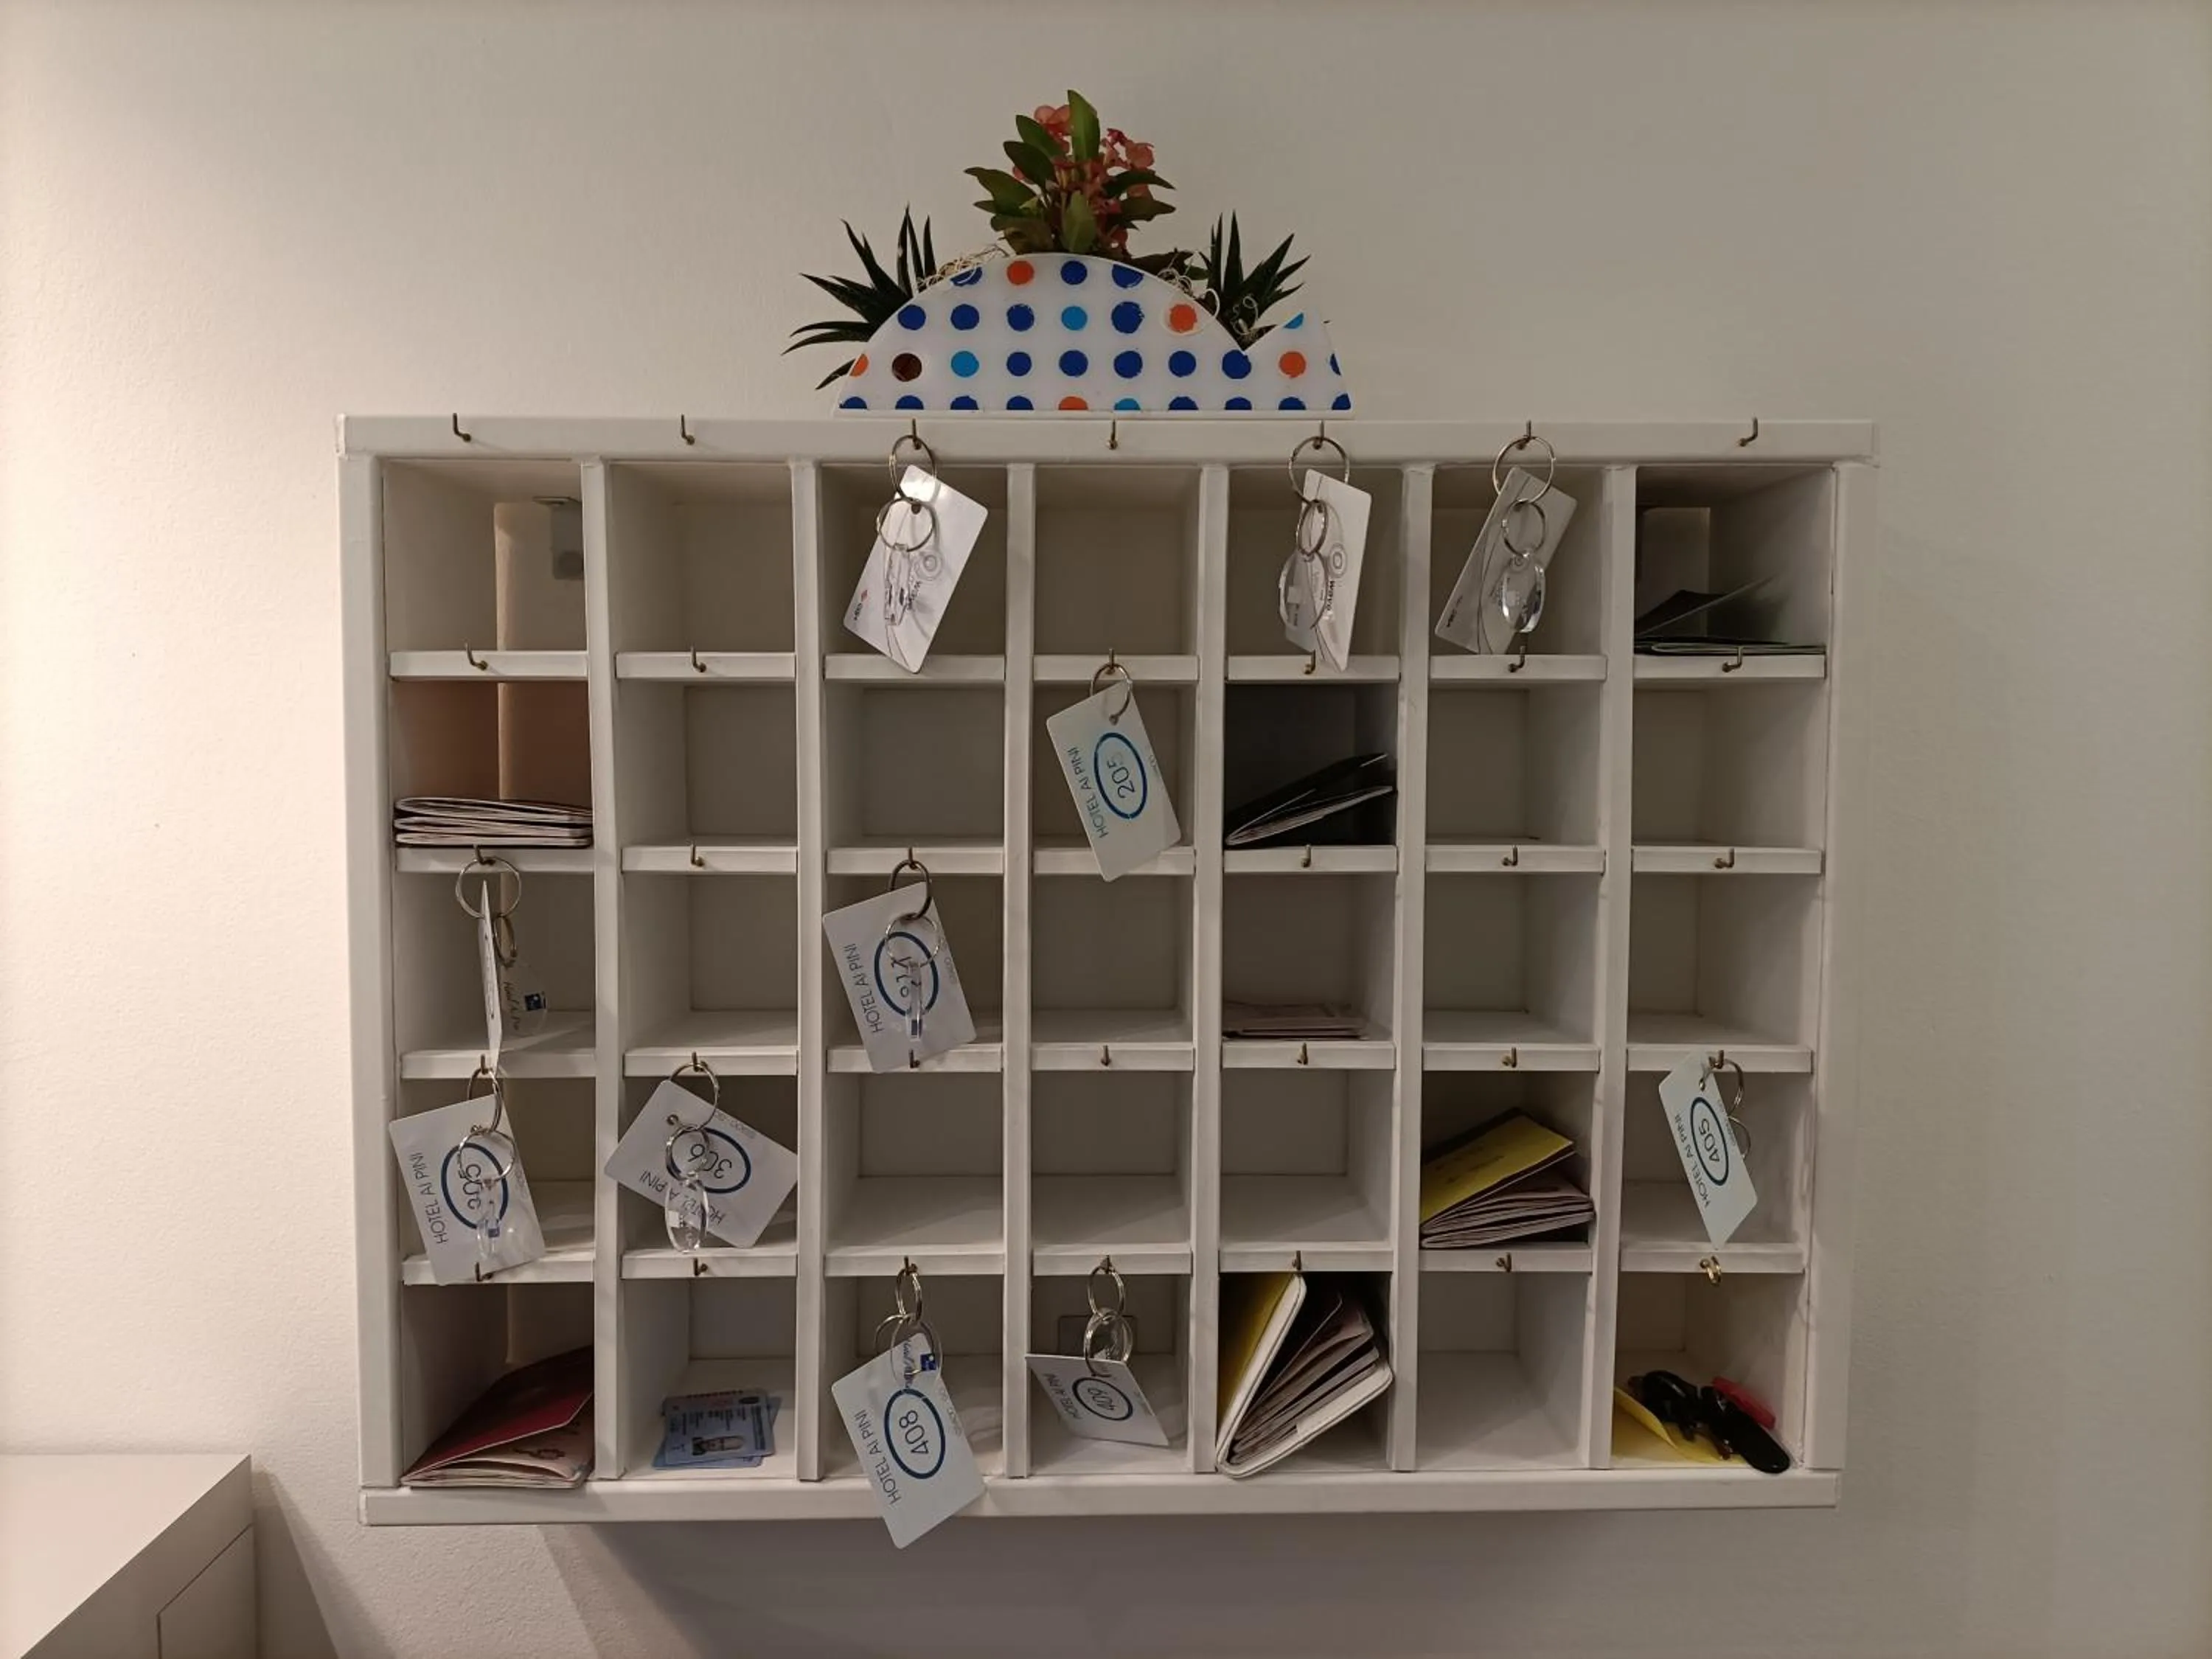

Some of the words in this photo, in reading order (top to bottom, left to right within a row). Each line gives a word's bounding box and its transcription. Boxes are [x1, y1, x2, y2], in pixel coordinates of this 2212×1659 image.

[1067, 746, 1086, 775] PINI
[1086, 794, 1109, 838] HOTEL
[843, 943, 863, 971] PINI
[860, 990, 886, 1033] HOTEL
[687, 1144, 733, 1179] 306
[1698, 1118, 1720, 1162] 405
[409, 1152, 430, 1180] PINI
[639, 1169, 668, 1192] PINI
[1691, 1161, 1711, 1208] HOTEL
[425, 1199, 449, 1245] HOTEL
[854, 1409, 874, 1439] PINI
[899, 1410, 929, 1455] 408
[875, 1456, 902, 1504] HOTEL
